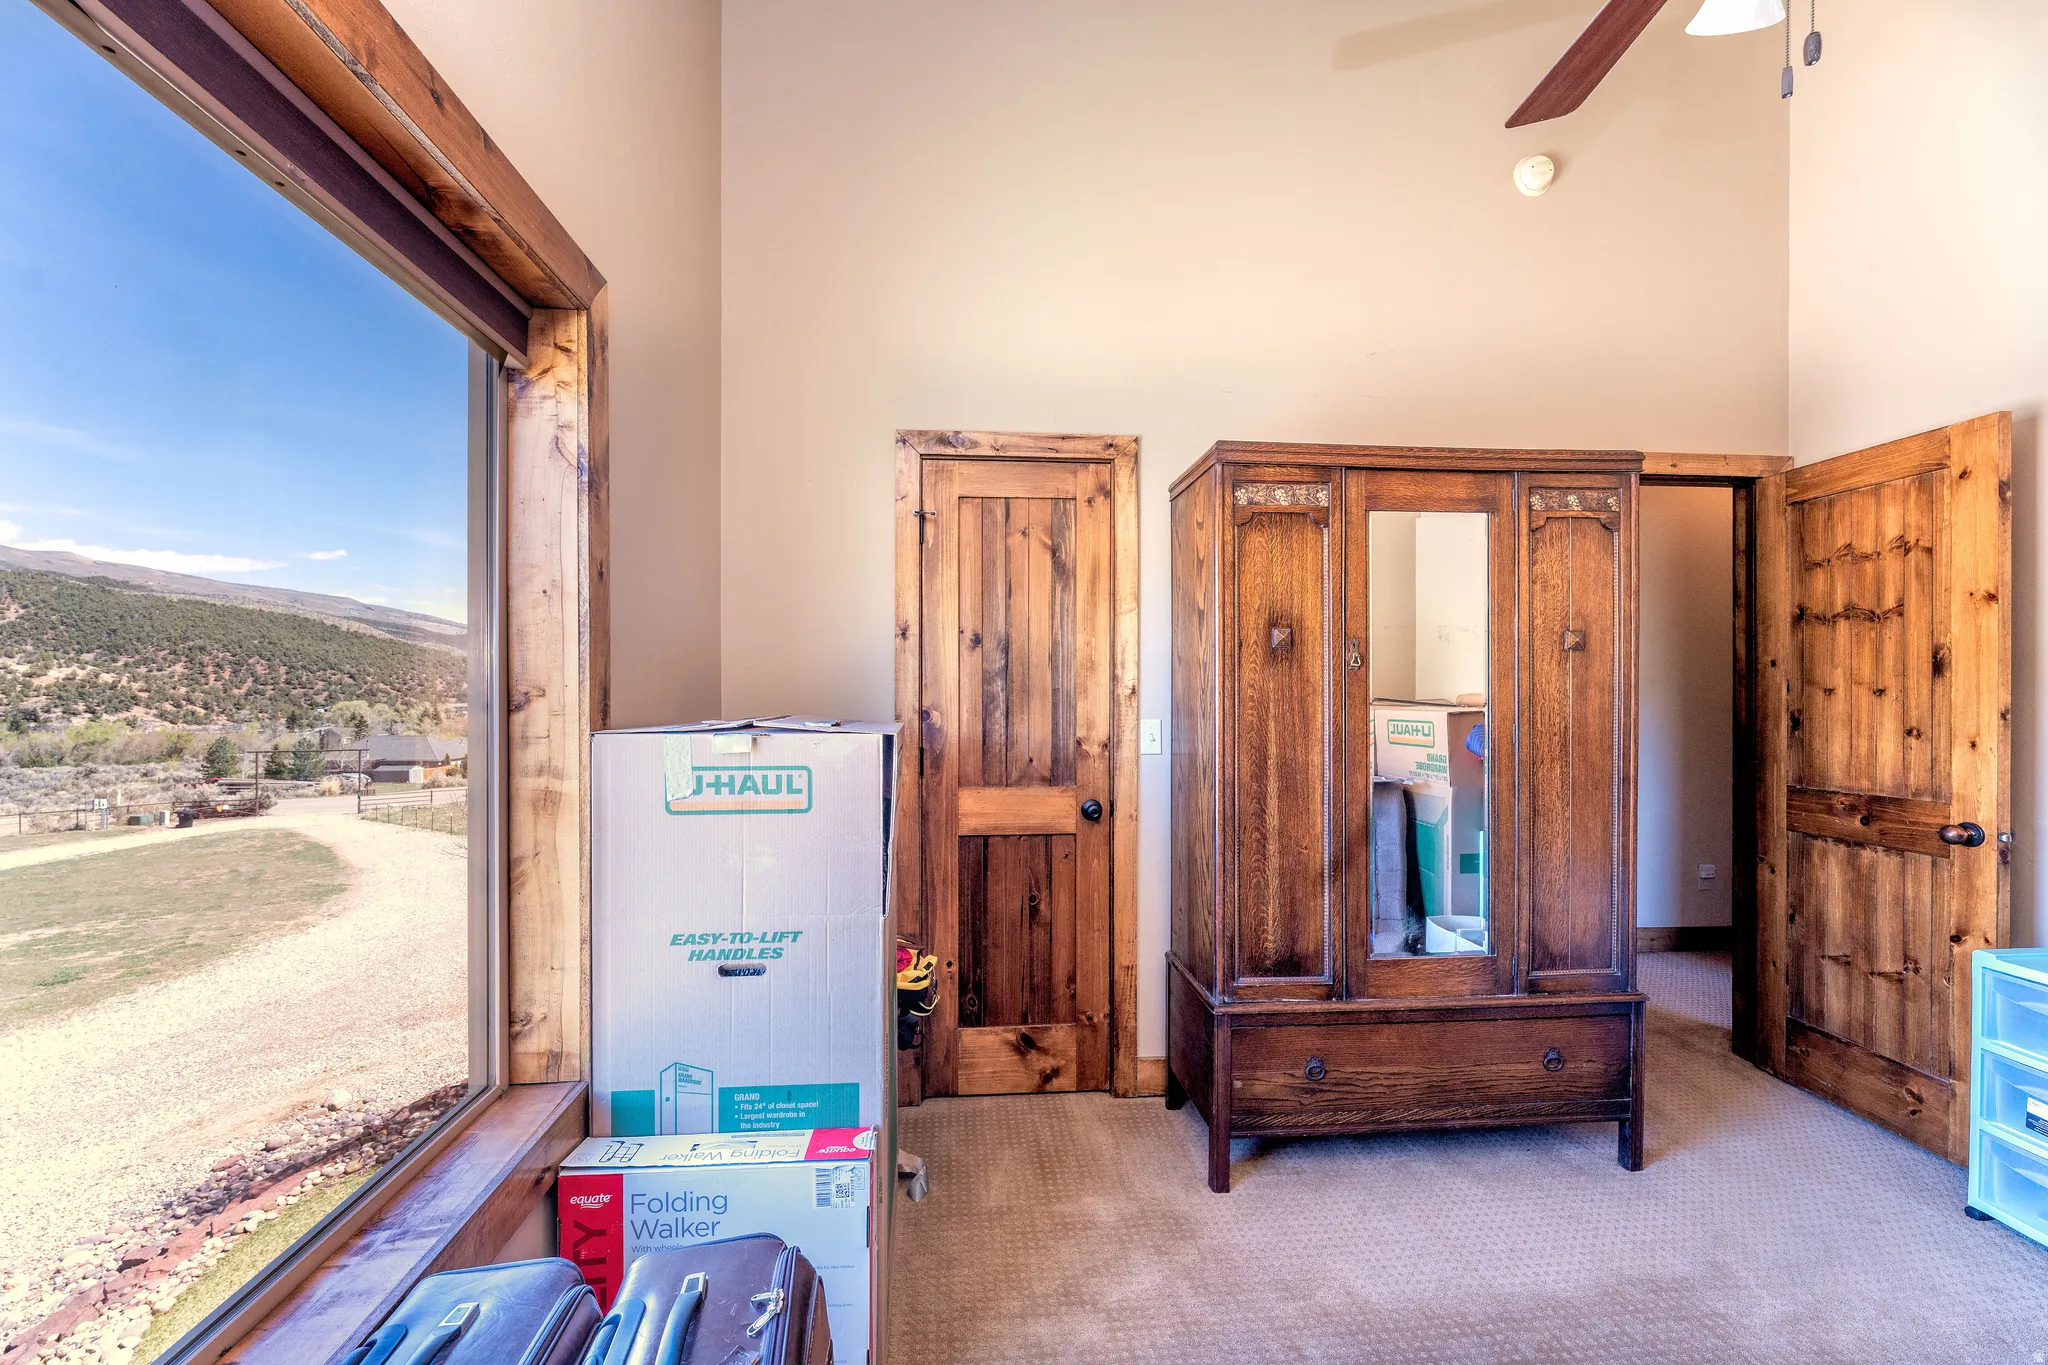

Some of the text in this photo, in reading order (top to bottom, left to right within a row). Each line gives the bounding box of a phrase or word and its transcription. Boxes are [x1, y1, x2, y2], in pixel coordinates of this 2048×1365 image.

[669, 931, 803, 947] EASY-TO-LIFT
[687, 947, 785, 962] HANDLES
[734, 1093, 760, 1101] GRAND
[768, 1102, 775, 1110] of
[775, 1102, 796, 1110] closet
[797, 1100, 819, 1110] space!
[740, 1113, 765, 1121] Largest
[766, 1111, 798, 1119] wardrobe
[752, 1121, 780, 1130] industry
[817, 1145, 857, 1154] equate
[658, 1149, 801, 1163] Folding Walker
[569, 1193, 613, 1207] equate
[630, 1191, 728, 1215] Folding
[630, 1218, 721, 1240] Walker
[631, 1244, 652, 1253] With
